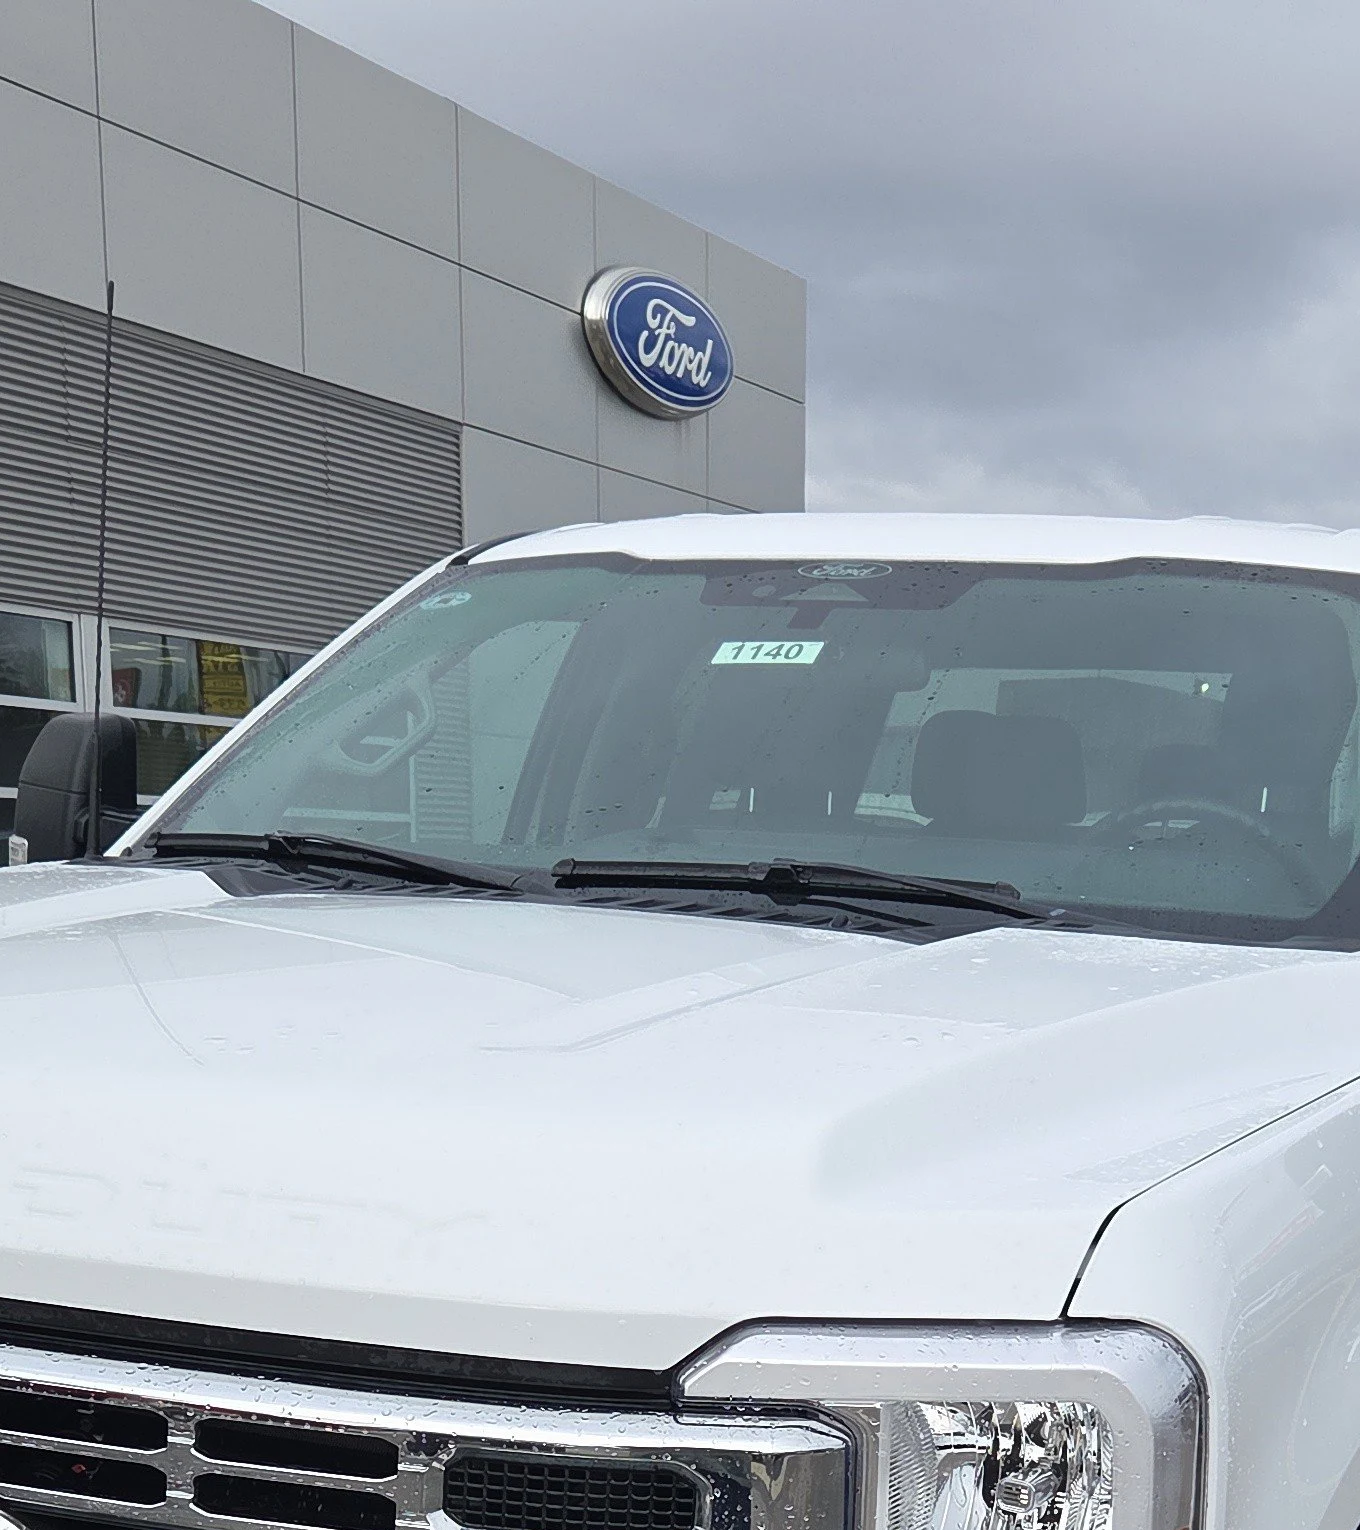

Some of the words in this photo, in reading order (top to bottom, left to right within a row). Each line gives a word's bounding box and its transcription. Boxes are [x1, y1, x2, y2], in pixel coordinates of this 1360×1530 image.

[638, 298, 713, 387] Ford
[812, 563, 878, 577] Ford
[730, 643, 804, 660] 1140
